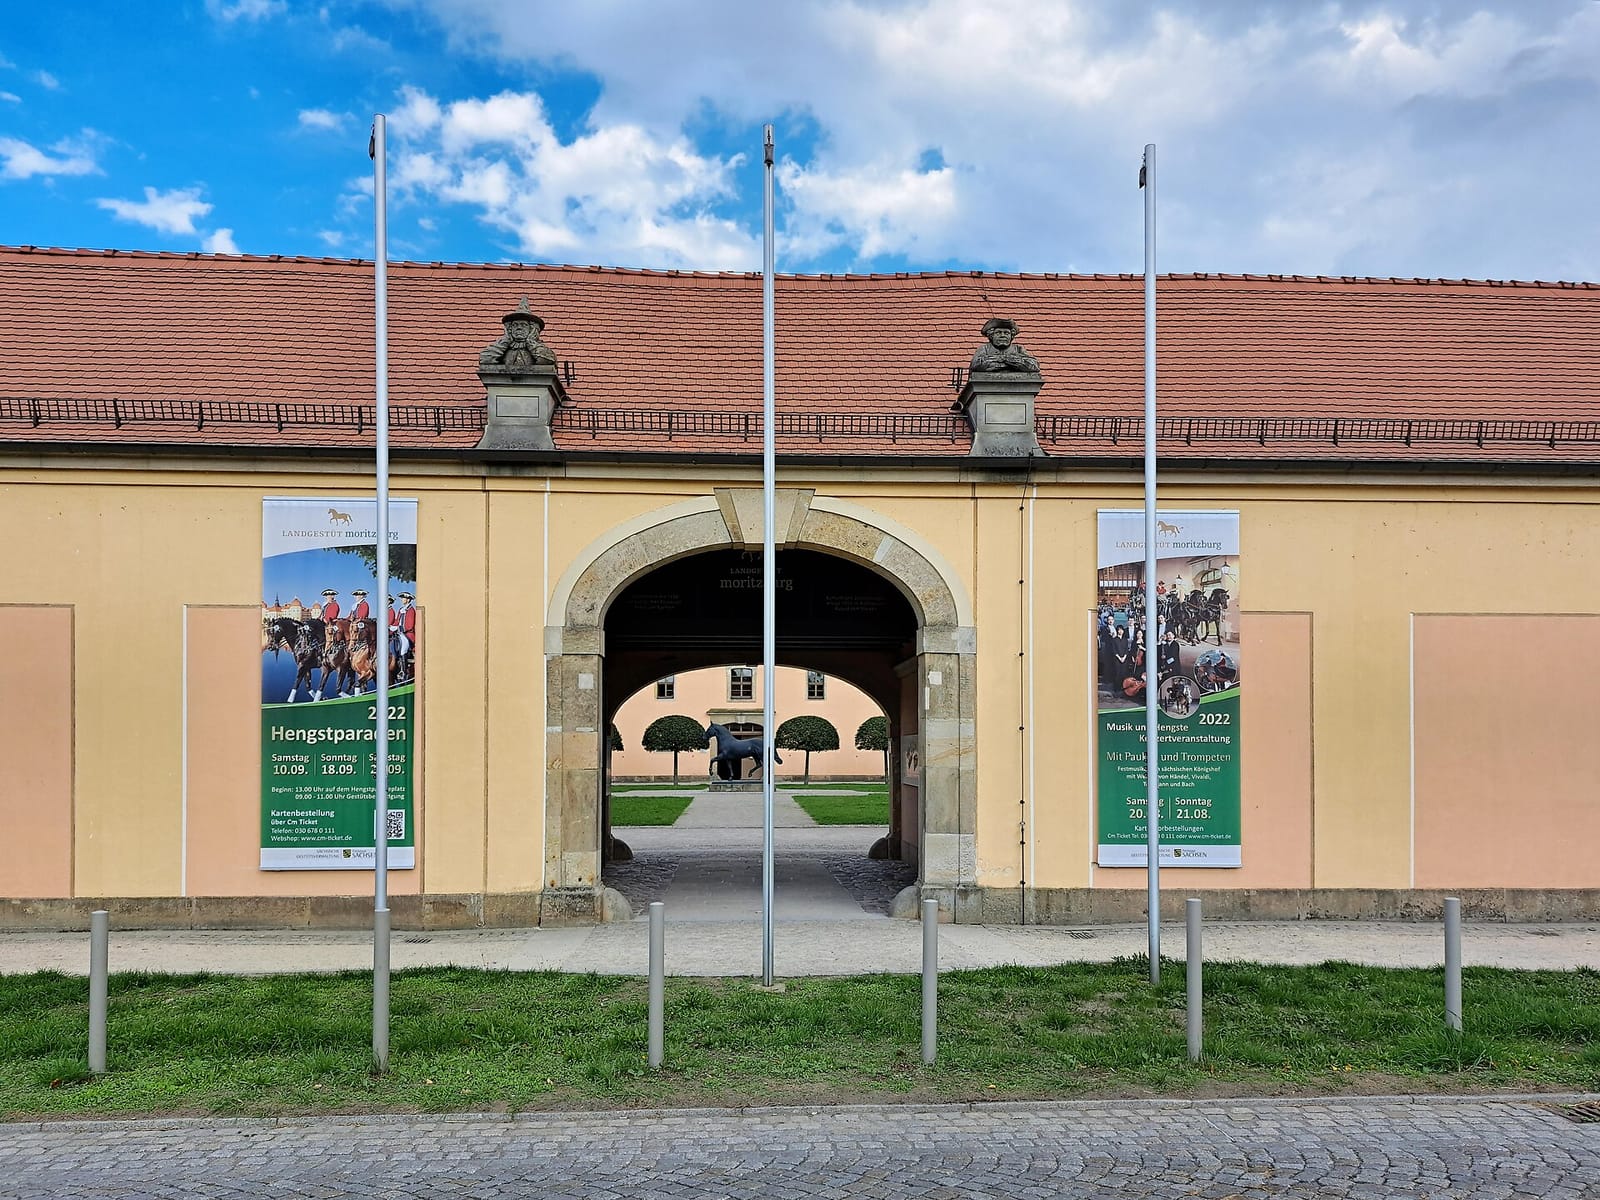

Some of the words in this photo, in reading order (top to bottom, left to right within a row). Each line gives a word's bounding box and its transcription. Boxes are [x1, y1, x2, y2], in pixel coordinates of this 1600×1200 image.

[345, 529, 399, 540] moritzrg
[1172, 540, 1222, 549] moritzburg
[368, 706, 406, 720] 222
[1199, 713, 1231, 725] 2022
[1106, 723, 1133, 731] Musik
[271, 726, 406, 744] Hengstparaen
[271, 754, 310, 763] Samstag
[320, 754, 358, 763] Sonntag
[369, 754, 406, 763] Sastag
[1106, 752, 1122, 761] Mit
[1125, 752, 1147, 761] Pauk
[1161, 752, 1179, 762] und
[1181, 752, 1231, 763] Trompeten
[273, 765, 308, 775] 10.09.
[321, 765, 356, 775] 18.09.
[1175, 797, 1212, 807] Sonntag
[270, 809, 335, 818] Kartenbestellung
[1176, 809, 1211, 819] 21.08.
[270, 834, 300, 842] Webshop:
